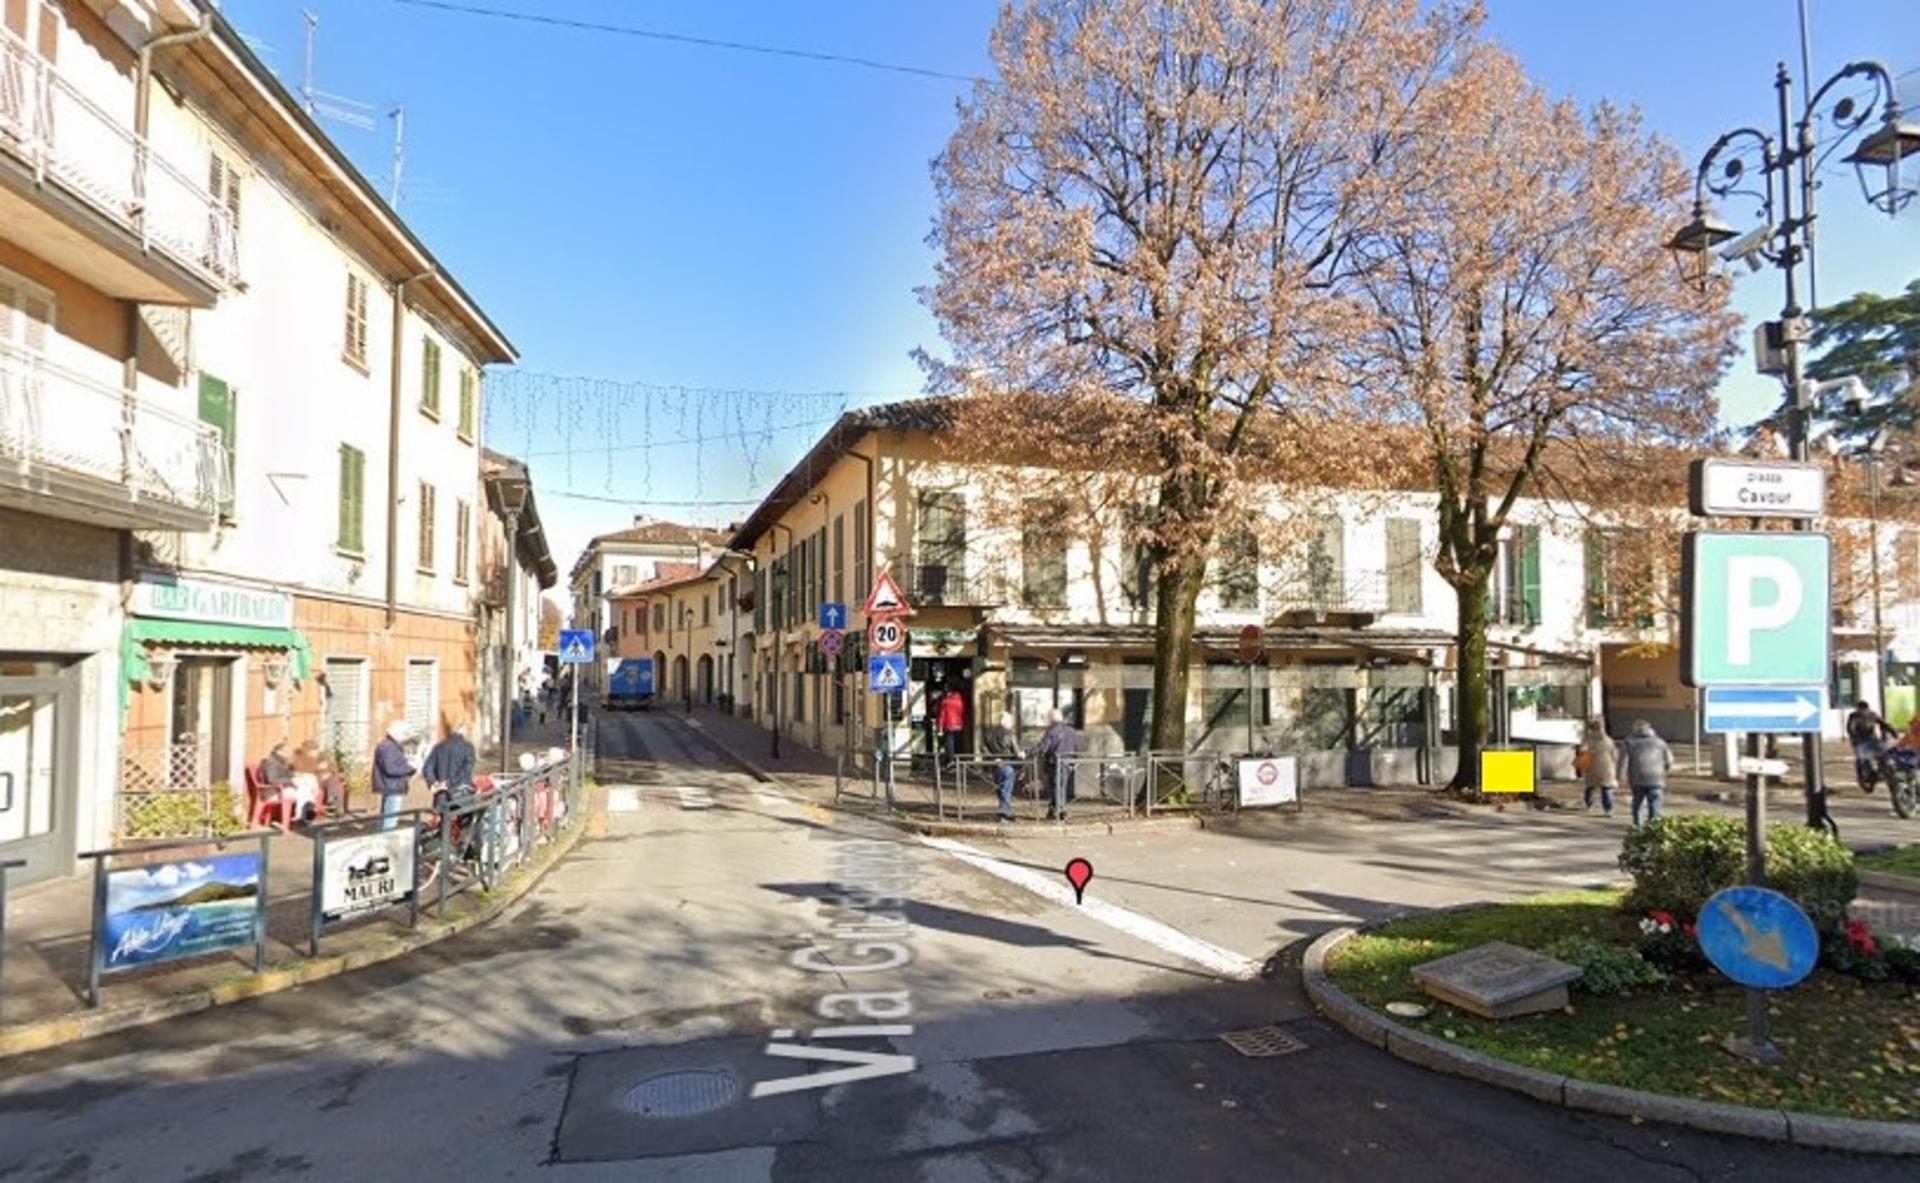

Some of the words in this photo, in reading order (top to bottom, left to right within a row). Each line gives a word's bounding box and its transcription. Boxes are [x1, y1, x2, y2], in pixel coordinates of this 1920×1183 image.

[1737, 487, 1792, 504] Cavour
[1727, 554, 1804, 666] P
[878, 626, 897, 641] 20
[343, 878, 395, 903] MAURI
